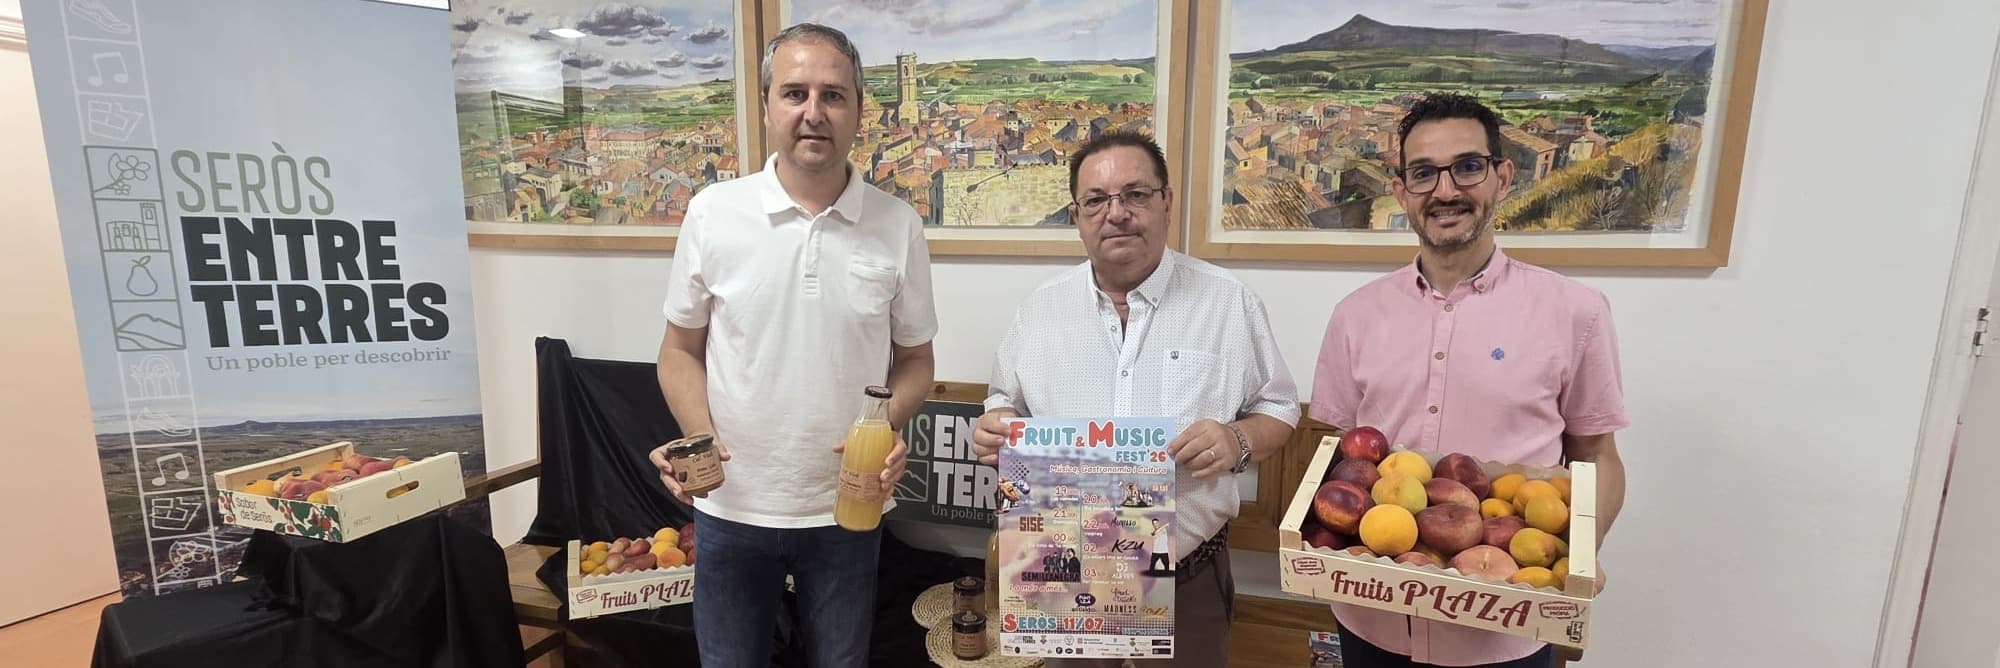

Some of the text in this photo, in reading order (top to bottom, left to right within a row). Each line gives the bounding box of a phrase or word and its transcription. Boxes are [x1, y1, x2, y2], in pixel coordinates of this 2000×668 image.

[170, 140, 335, 216] SERÒS
[180, 216, 401, 281] ENTRE
[190, 282, 450, 348] TERRES
[205, 347, 452, 372] Un poble per descobrir
[933, 414, 979, 460] EN
[1075, 436, 1085, 448] &
[1088, 421, 1167, 448] MUSIC
[932, 461, 998, 510] TER
[931, 504, 948, 517] Un
[951, 505, 984, 520] poble
[600, 590, 637, 609] Fruits
[640, 578, 695, 603] PLAZ
[1331, 570, 1533, 628] Fruits PLAZA
[1063, 616, 1104, 631] 11/07
